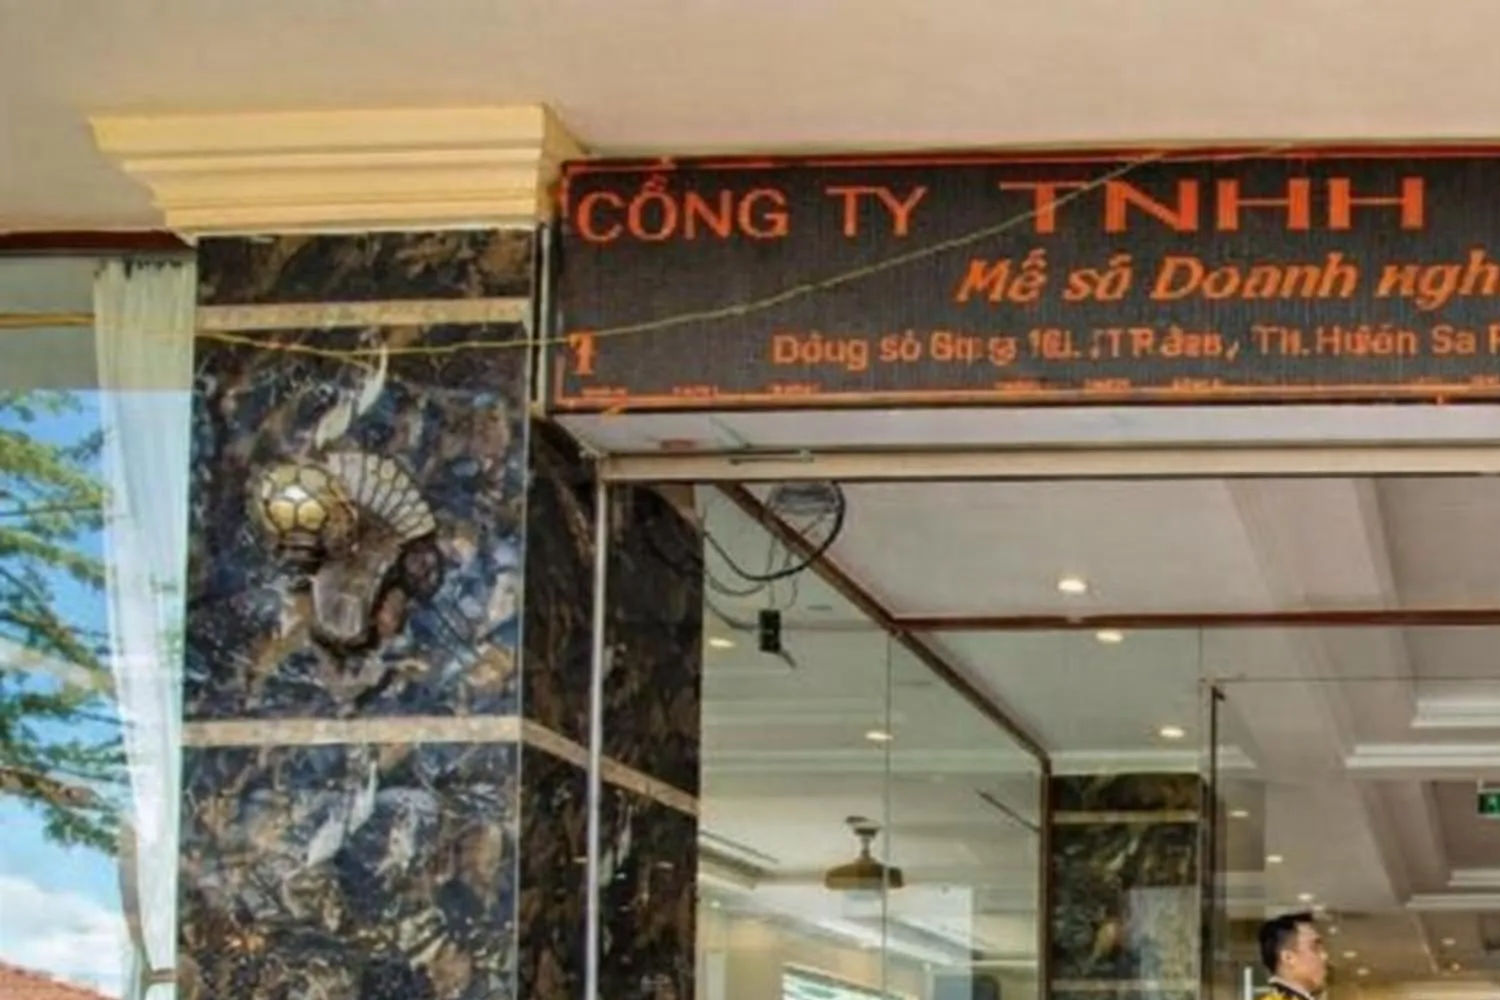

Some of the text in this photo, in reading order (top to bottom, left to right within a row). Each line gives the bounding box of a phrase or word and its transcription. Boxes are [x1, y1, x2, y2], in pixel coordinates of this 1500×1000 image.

[824, 184, 928, 238] TY
[1000, 178, 1425, 234] TNHH
[1150, 250, 1358, 300] Doanh
[1431, 323, 1476, 354] Sa
